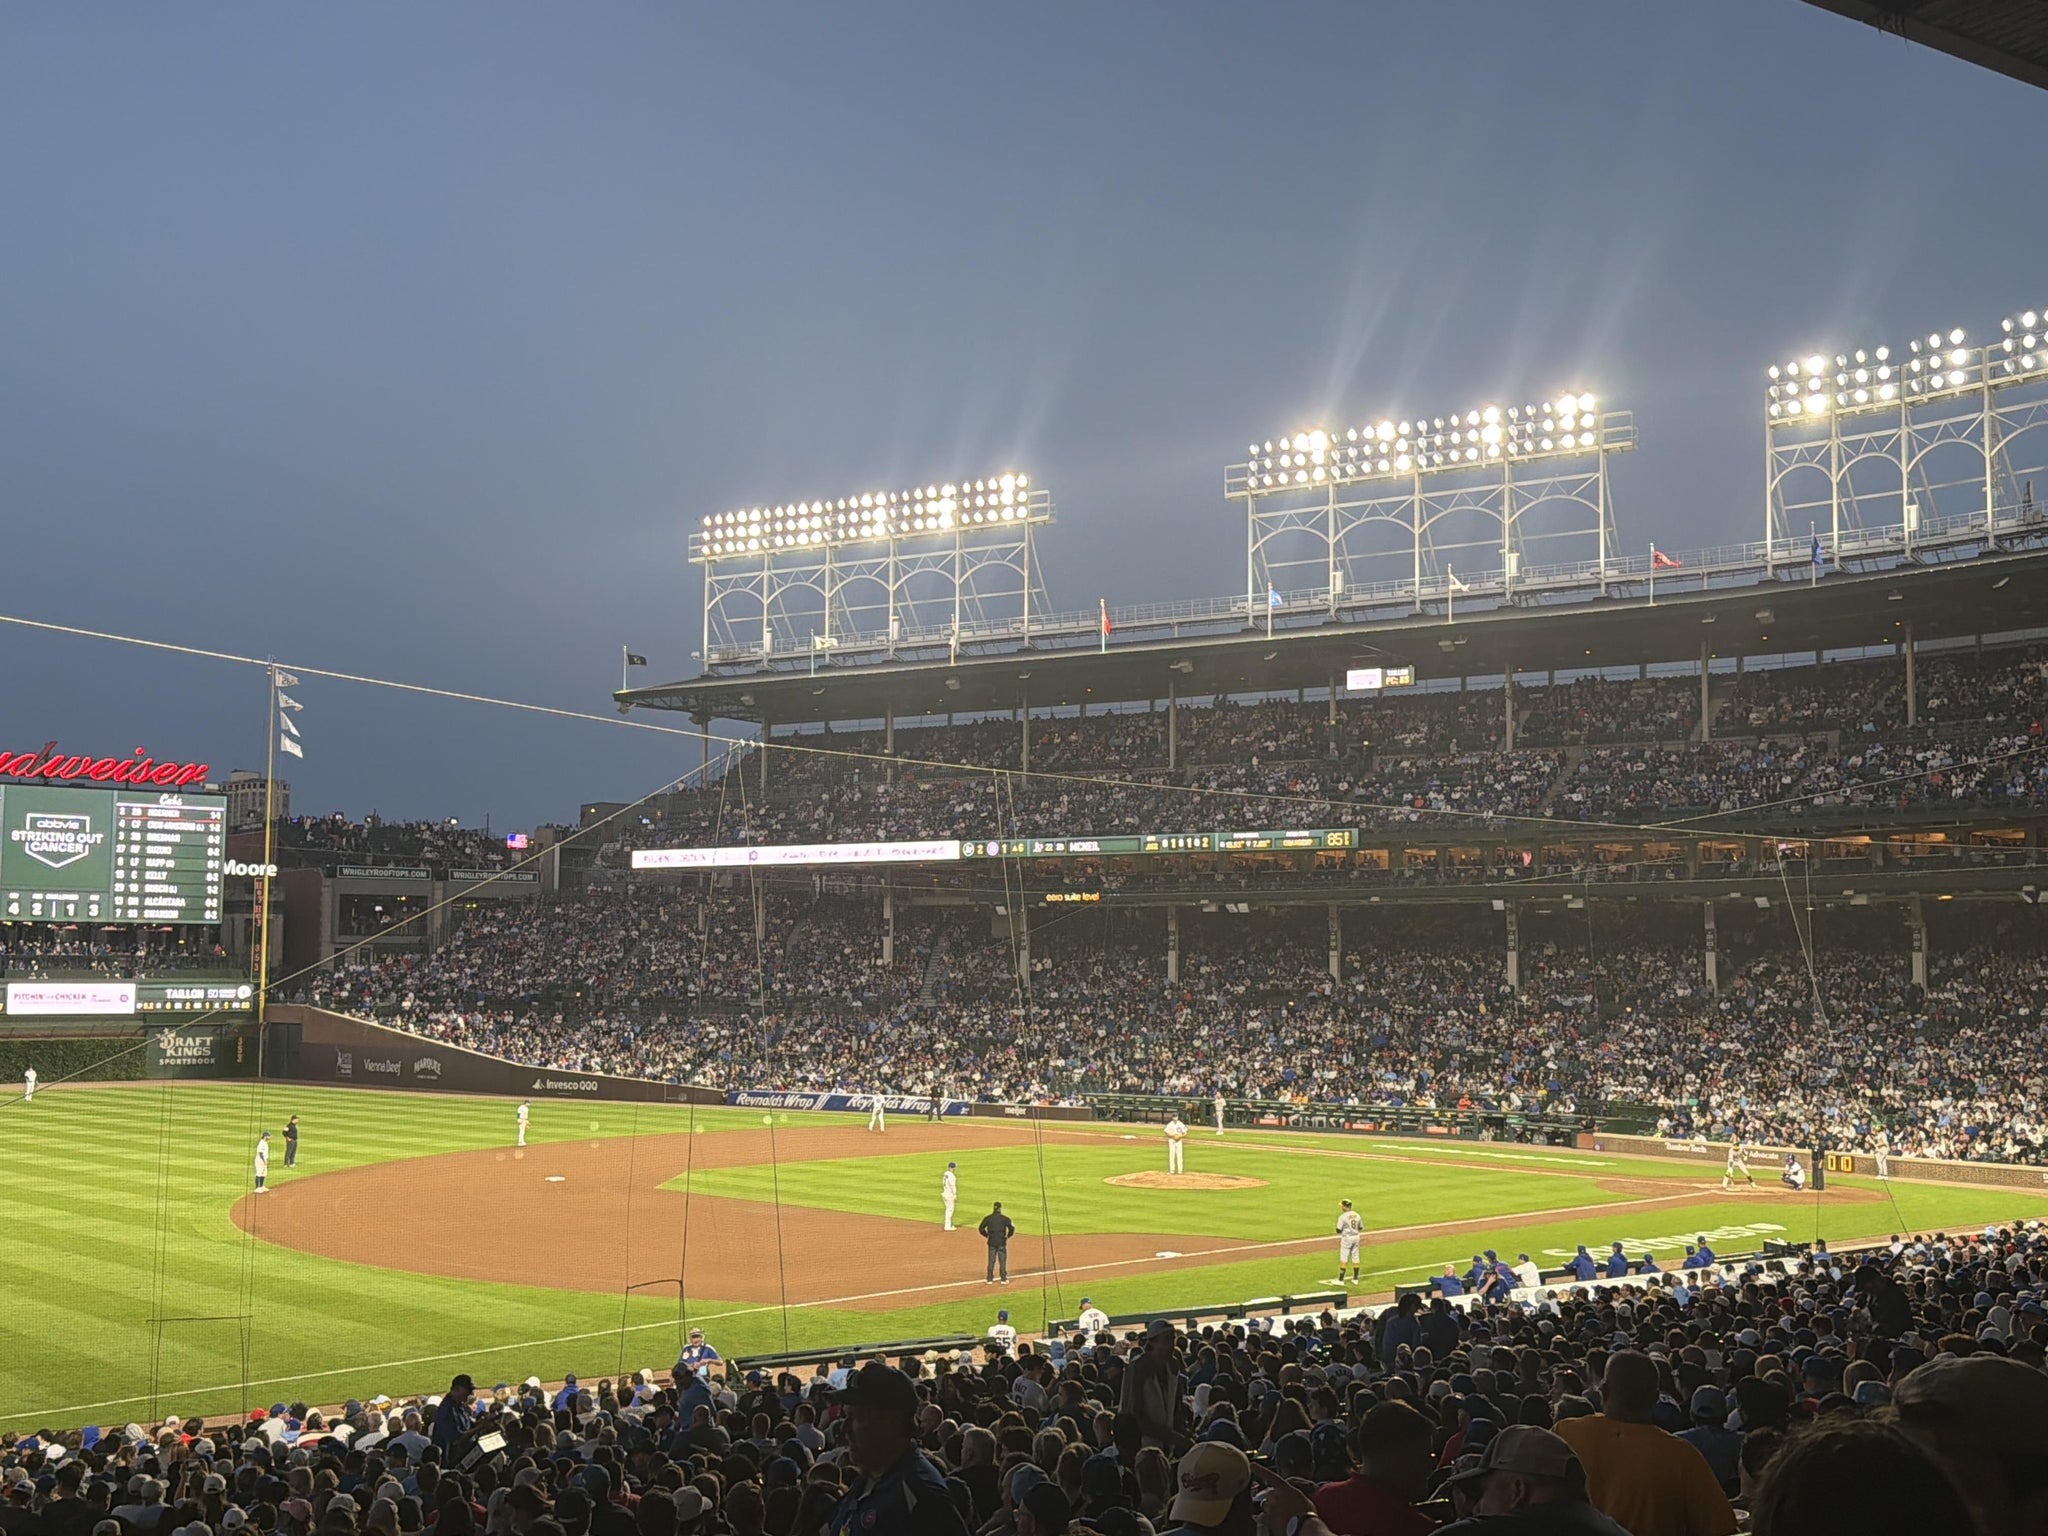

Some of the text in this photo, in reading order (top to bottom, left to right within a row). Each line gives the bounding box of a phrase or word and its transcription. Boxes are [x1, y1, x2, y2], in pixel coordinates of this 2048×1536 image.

[36, 819, 80, 830] abbvie
[11, 829, 104, 844] STRIKING OUT
[1327, 832, 1343, 846] 85
[30, 841, 84, 853] CANCER
[223, 859, 278, 877] Moore
[1082, 892, 1100, 902] level
[8, 902, 99, 917] 4 2 1 3
[166, 1047, 211, 1057] KINGS
[159, 1057, 216, 1066] SPORTSBOOK
[546, 1079, 598, 1091] Invesco QQQ
[736, 1093, 814, 1110] Reynolds Wrap
[846, 1094, 900, 1110] Reylds
